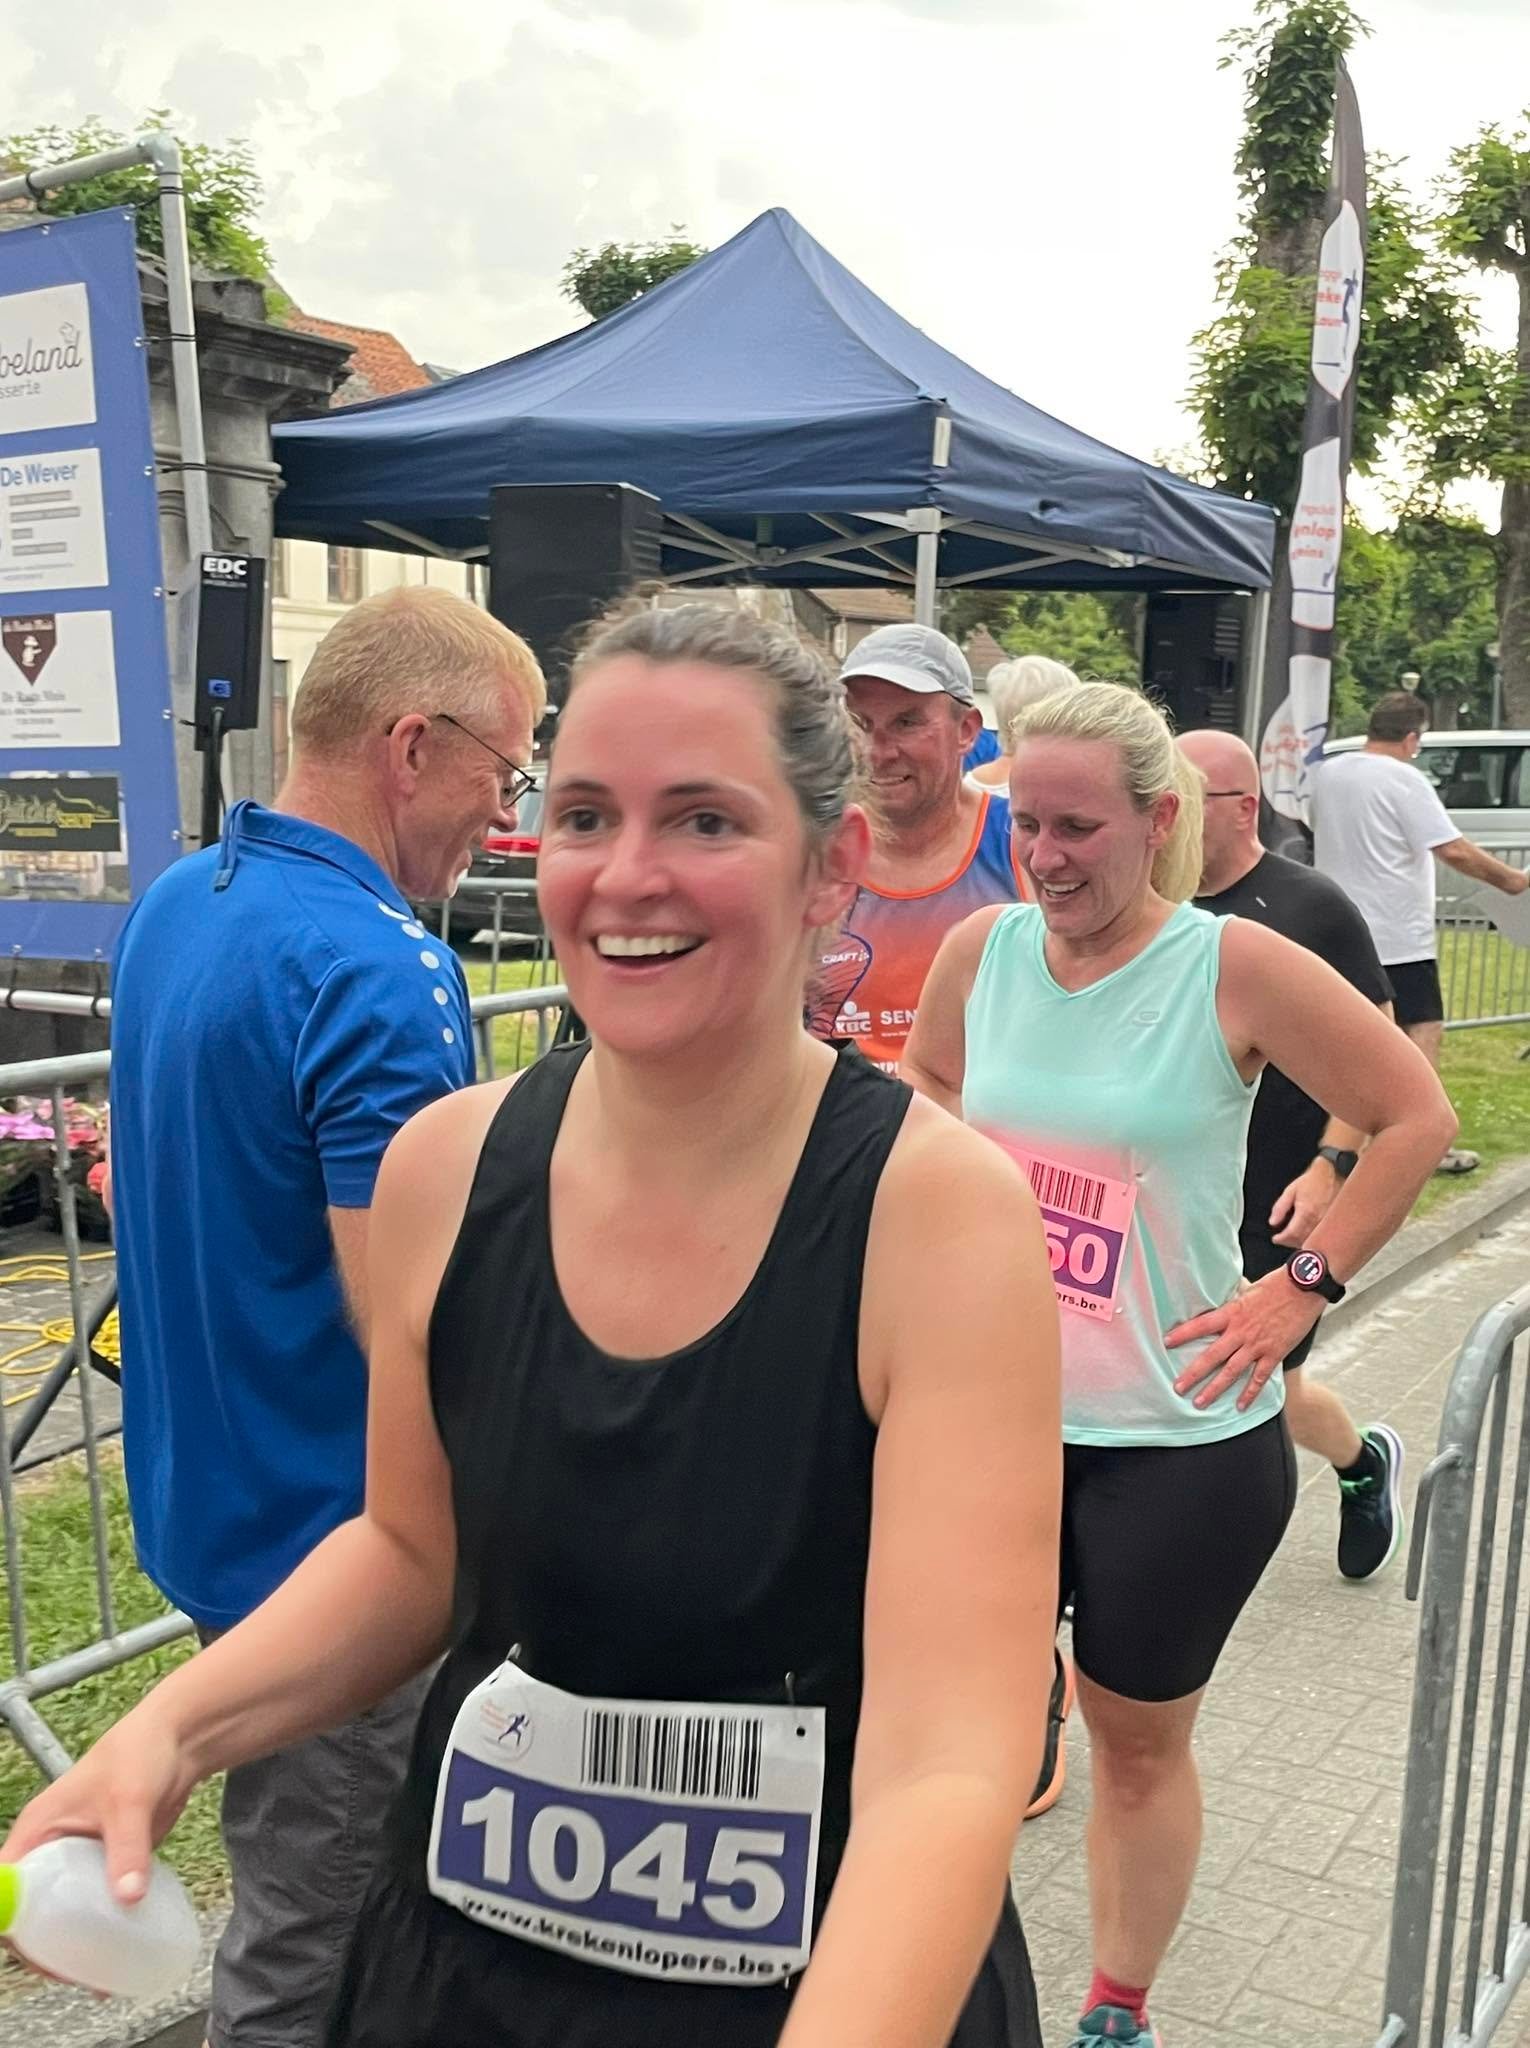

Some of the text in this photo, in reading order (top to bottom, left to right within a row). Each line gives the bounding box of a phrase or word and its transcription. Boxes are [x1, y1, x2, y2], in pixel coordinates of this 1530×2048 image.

[0, 463, 80, 487] De Wever
[203, 557, 248, 576] EDC
[822, 952, 859, 964] CRAFT
[835, 1019, 872, 1033] KBC
[461, 1786, 786, 1930] 1045
